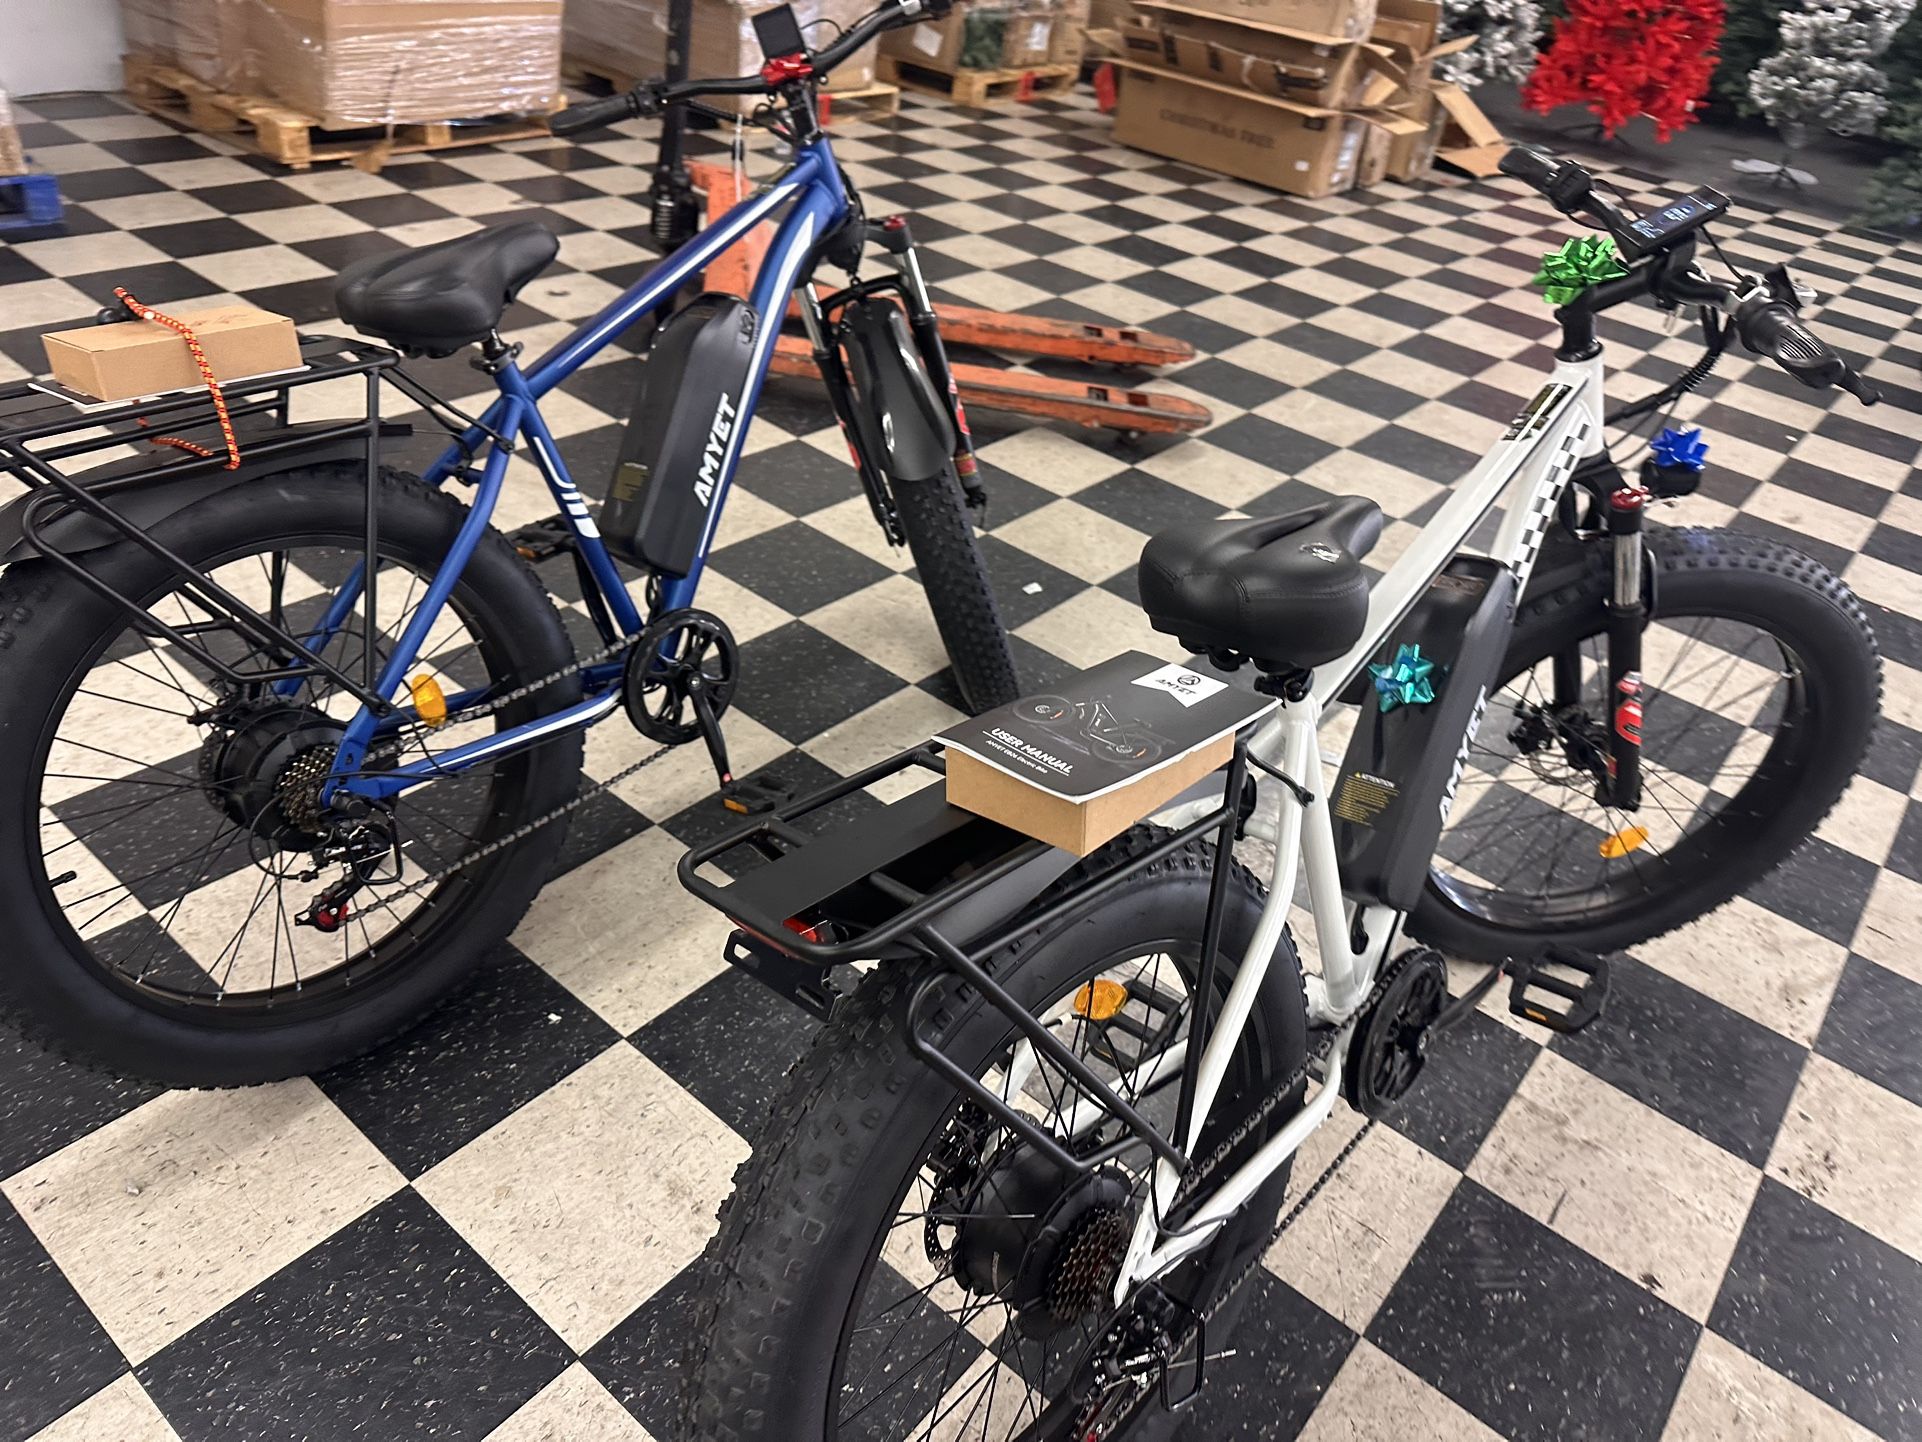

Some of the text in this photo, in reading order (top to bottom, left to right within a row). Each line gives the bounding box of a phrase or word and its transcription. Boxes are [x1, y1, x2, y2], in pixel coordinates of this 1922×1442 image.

[693, 391, 736, 508] AMYET
[991, 727, 1073, 774] USER MANUAL
[1439, 684, 1487, 826] AMYET
